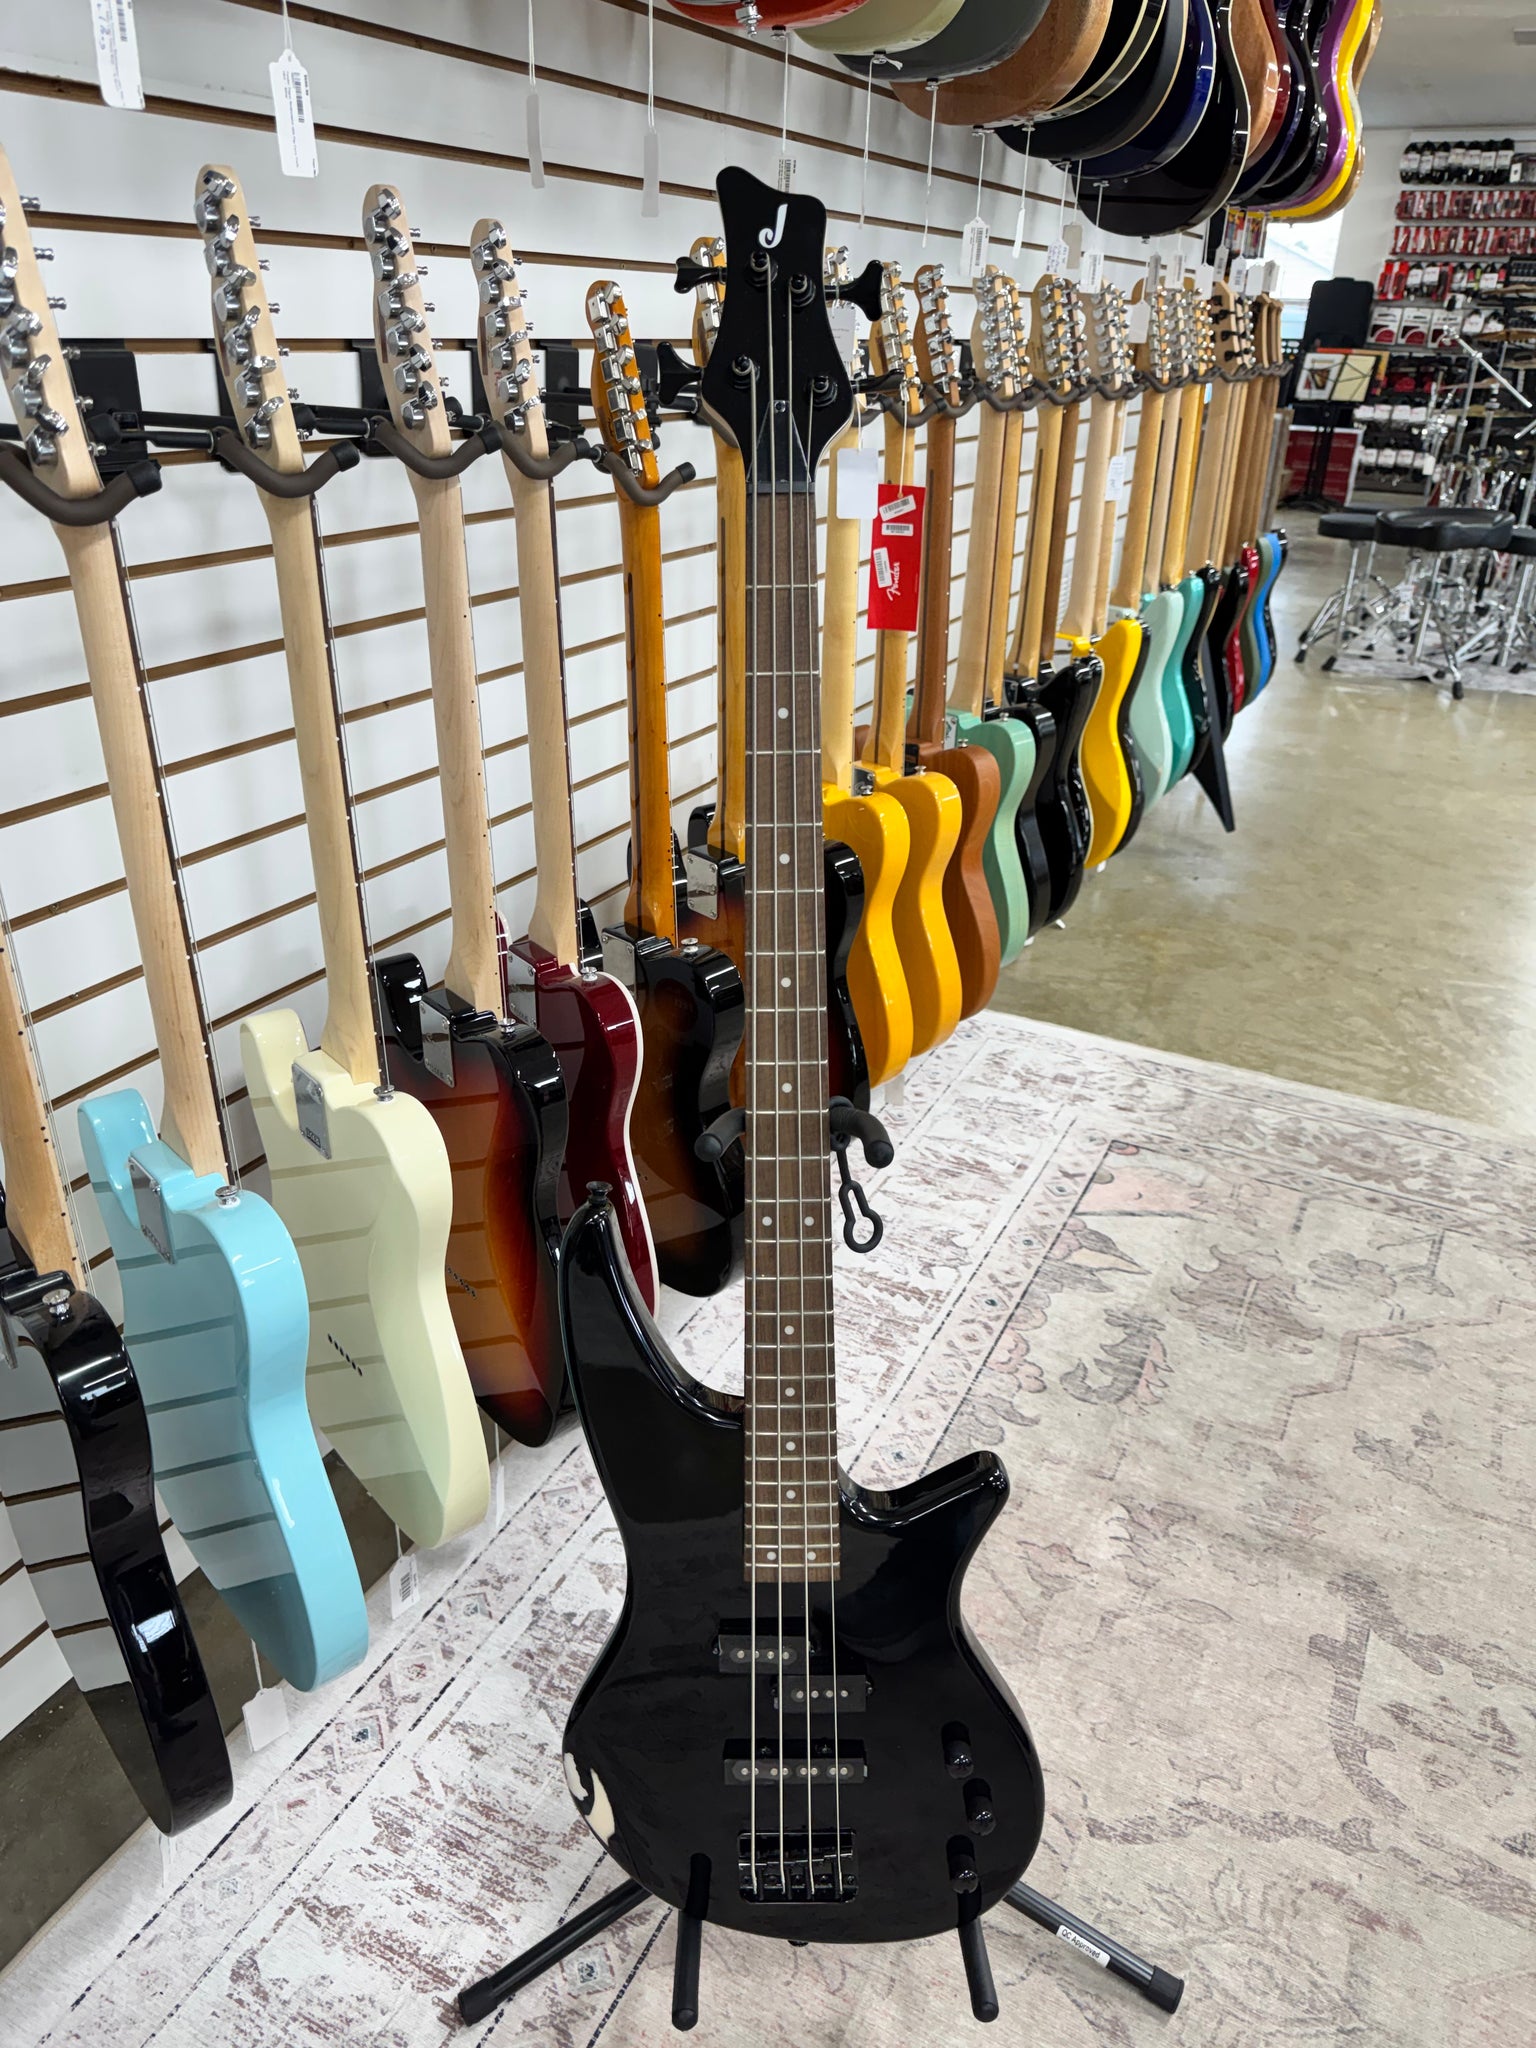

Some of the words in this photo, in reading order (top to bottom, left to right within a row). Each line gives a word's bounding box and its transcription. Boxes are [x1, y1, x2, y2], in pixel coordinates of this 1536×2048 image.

[759, 203, 788, 249] J
[886, 562, 901, 601] Fender
[1062, 1929, 1072, 1939] QC
[1071, 1936, 1100, 1958] Approved
